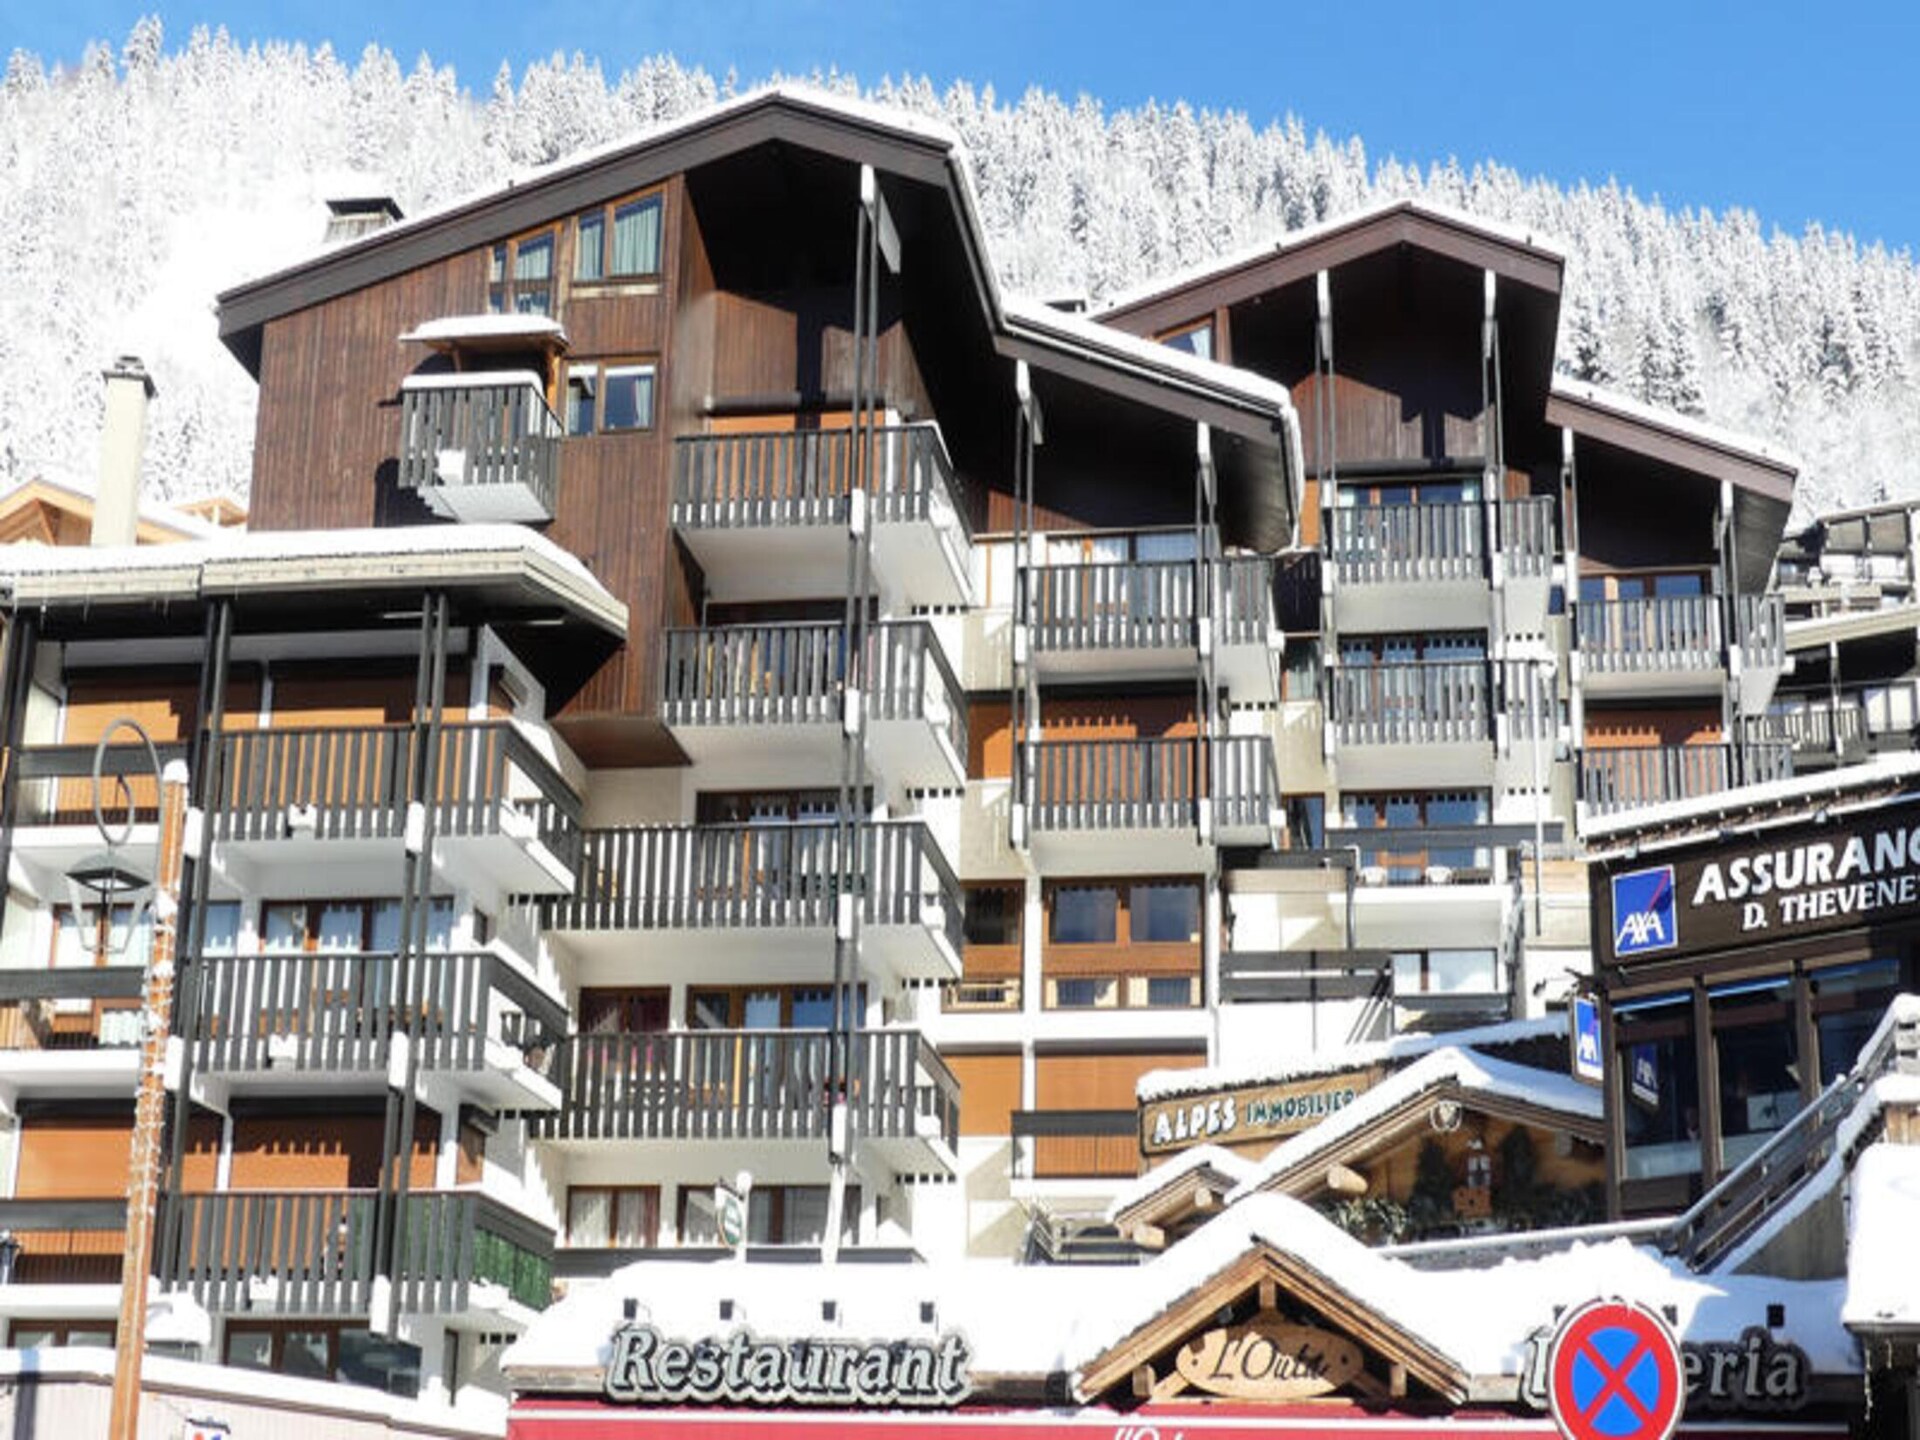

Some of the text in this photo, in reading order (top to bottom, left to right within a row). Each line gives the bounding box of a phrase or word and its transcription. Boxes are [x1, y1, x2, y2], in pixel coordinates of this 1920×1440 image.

[1742, 874, 1920, 931] D. THEVENE
[1615, 911, 1665, 947] AXA
[1153, 1097, 1238, 1145] ALPES
[608, 1327, 968, 1395] Restaurant
